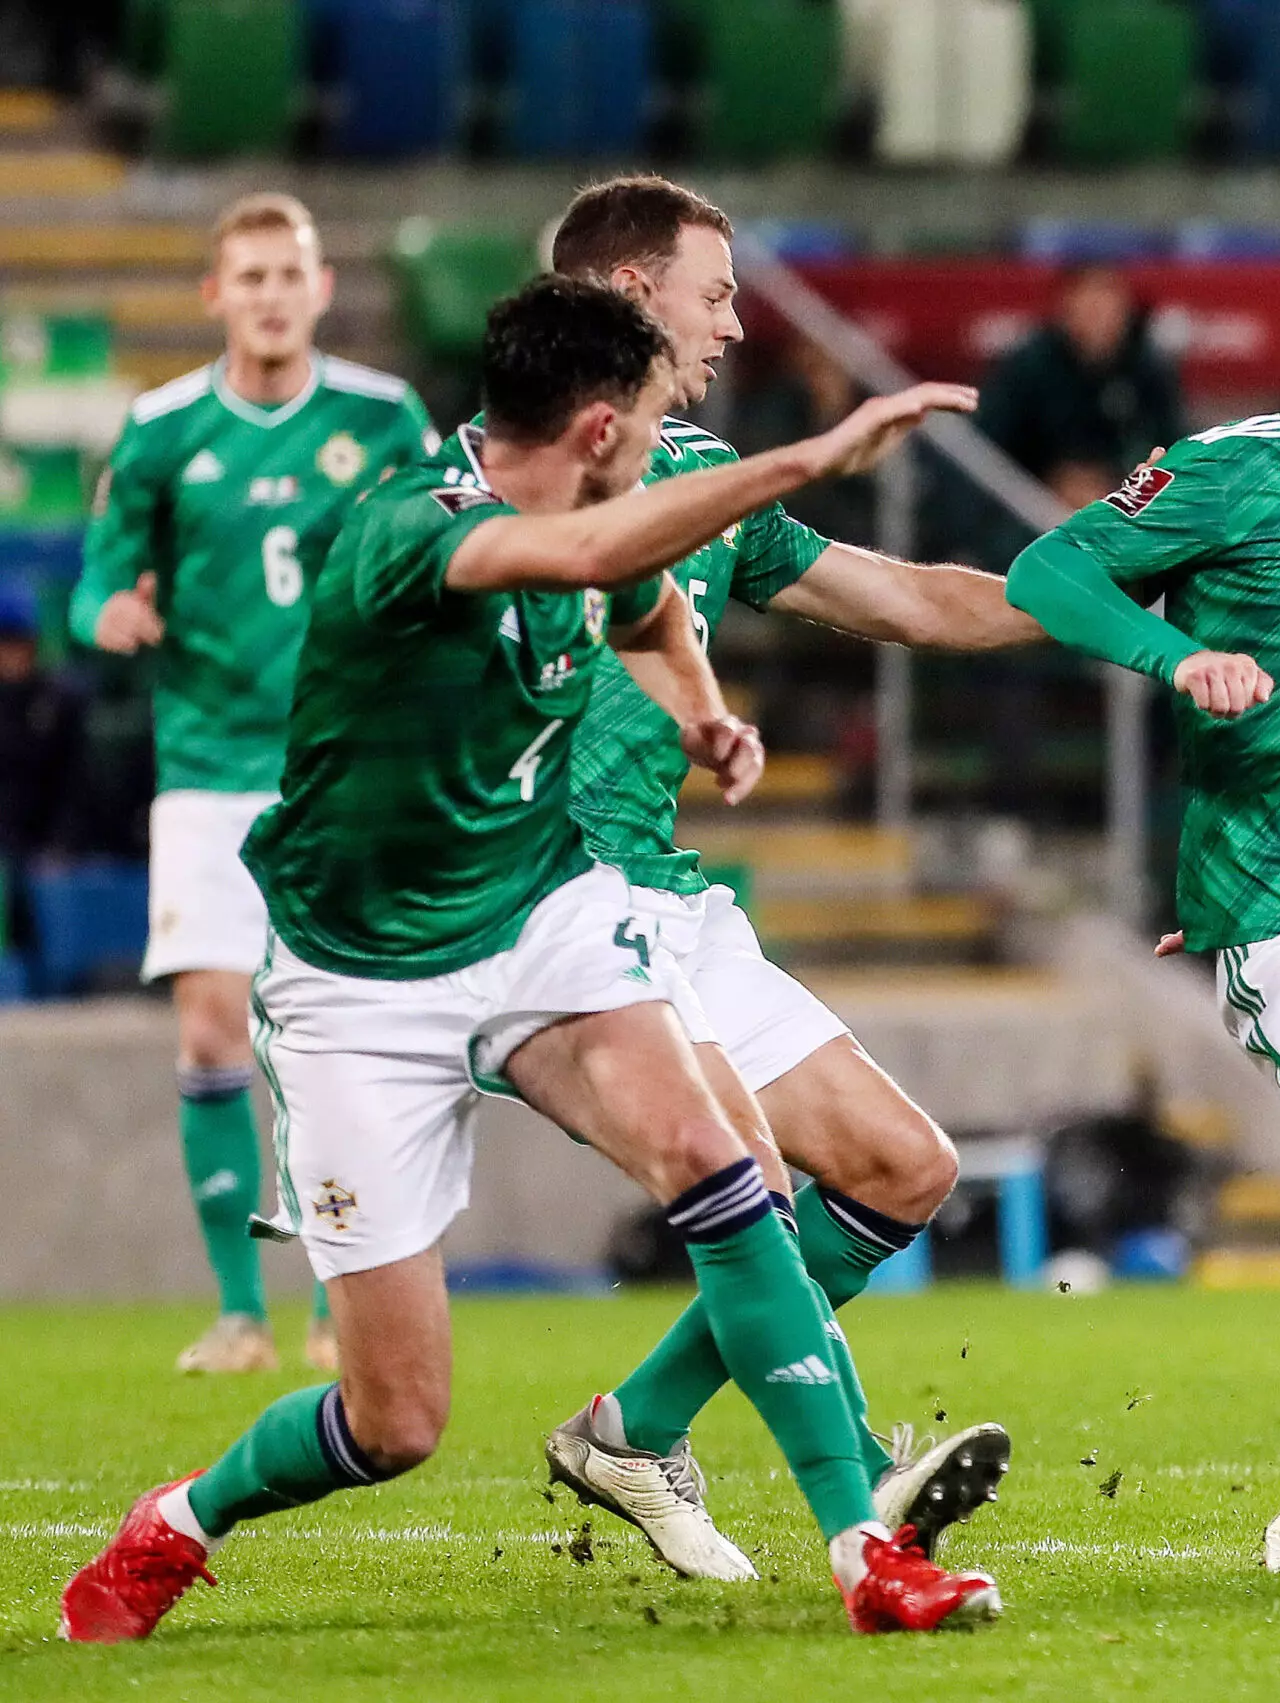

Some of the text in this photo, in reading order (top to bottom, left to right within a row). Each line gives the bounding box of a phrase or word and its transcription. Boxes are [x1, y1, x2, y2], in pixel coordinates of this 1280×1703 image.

[261, 525, 303, 607] 6
[508, 718, 565, 802] 4
[614, 916, 651, 968] 4
